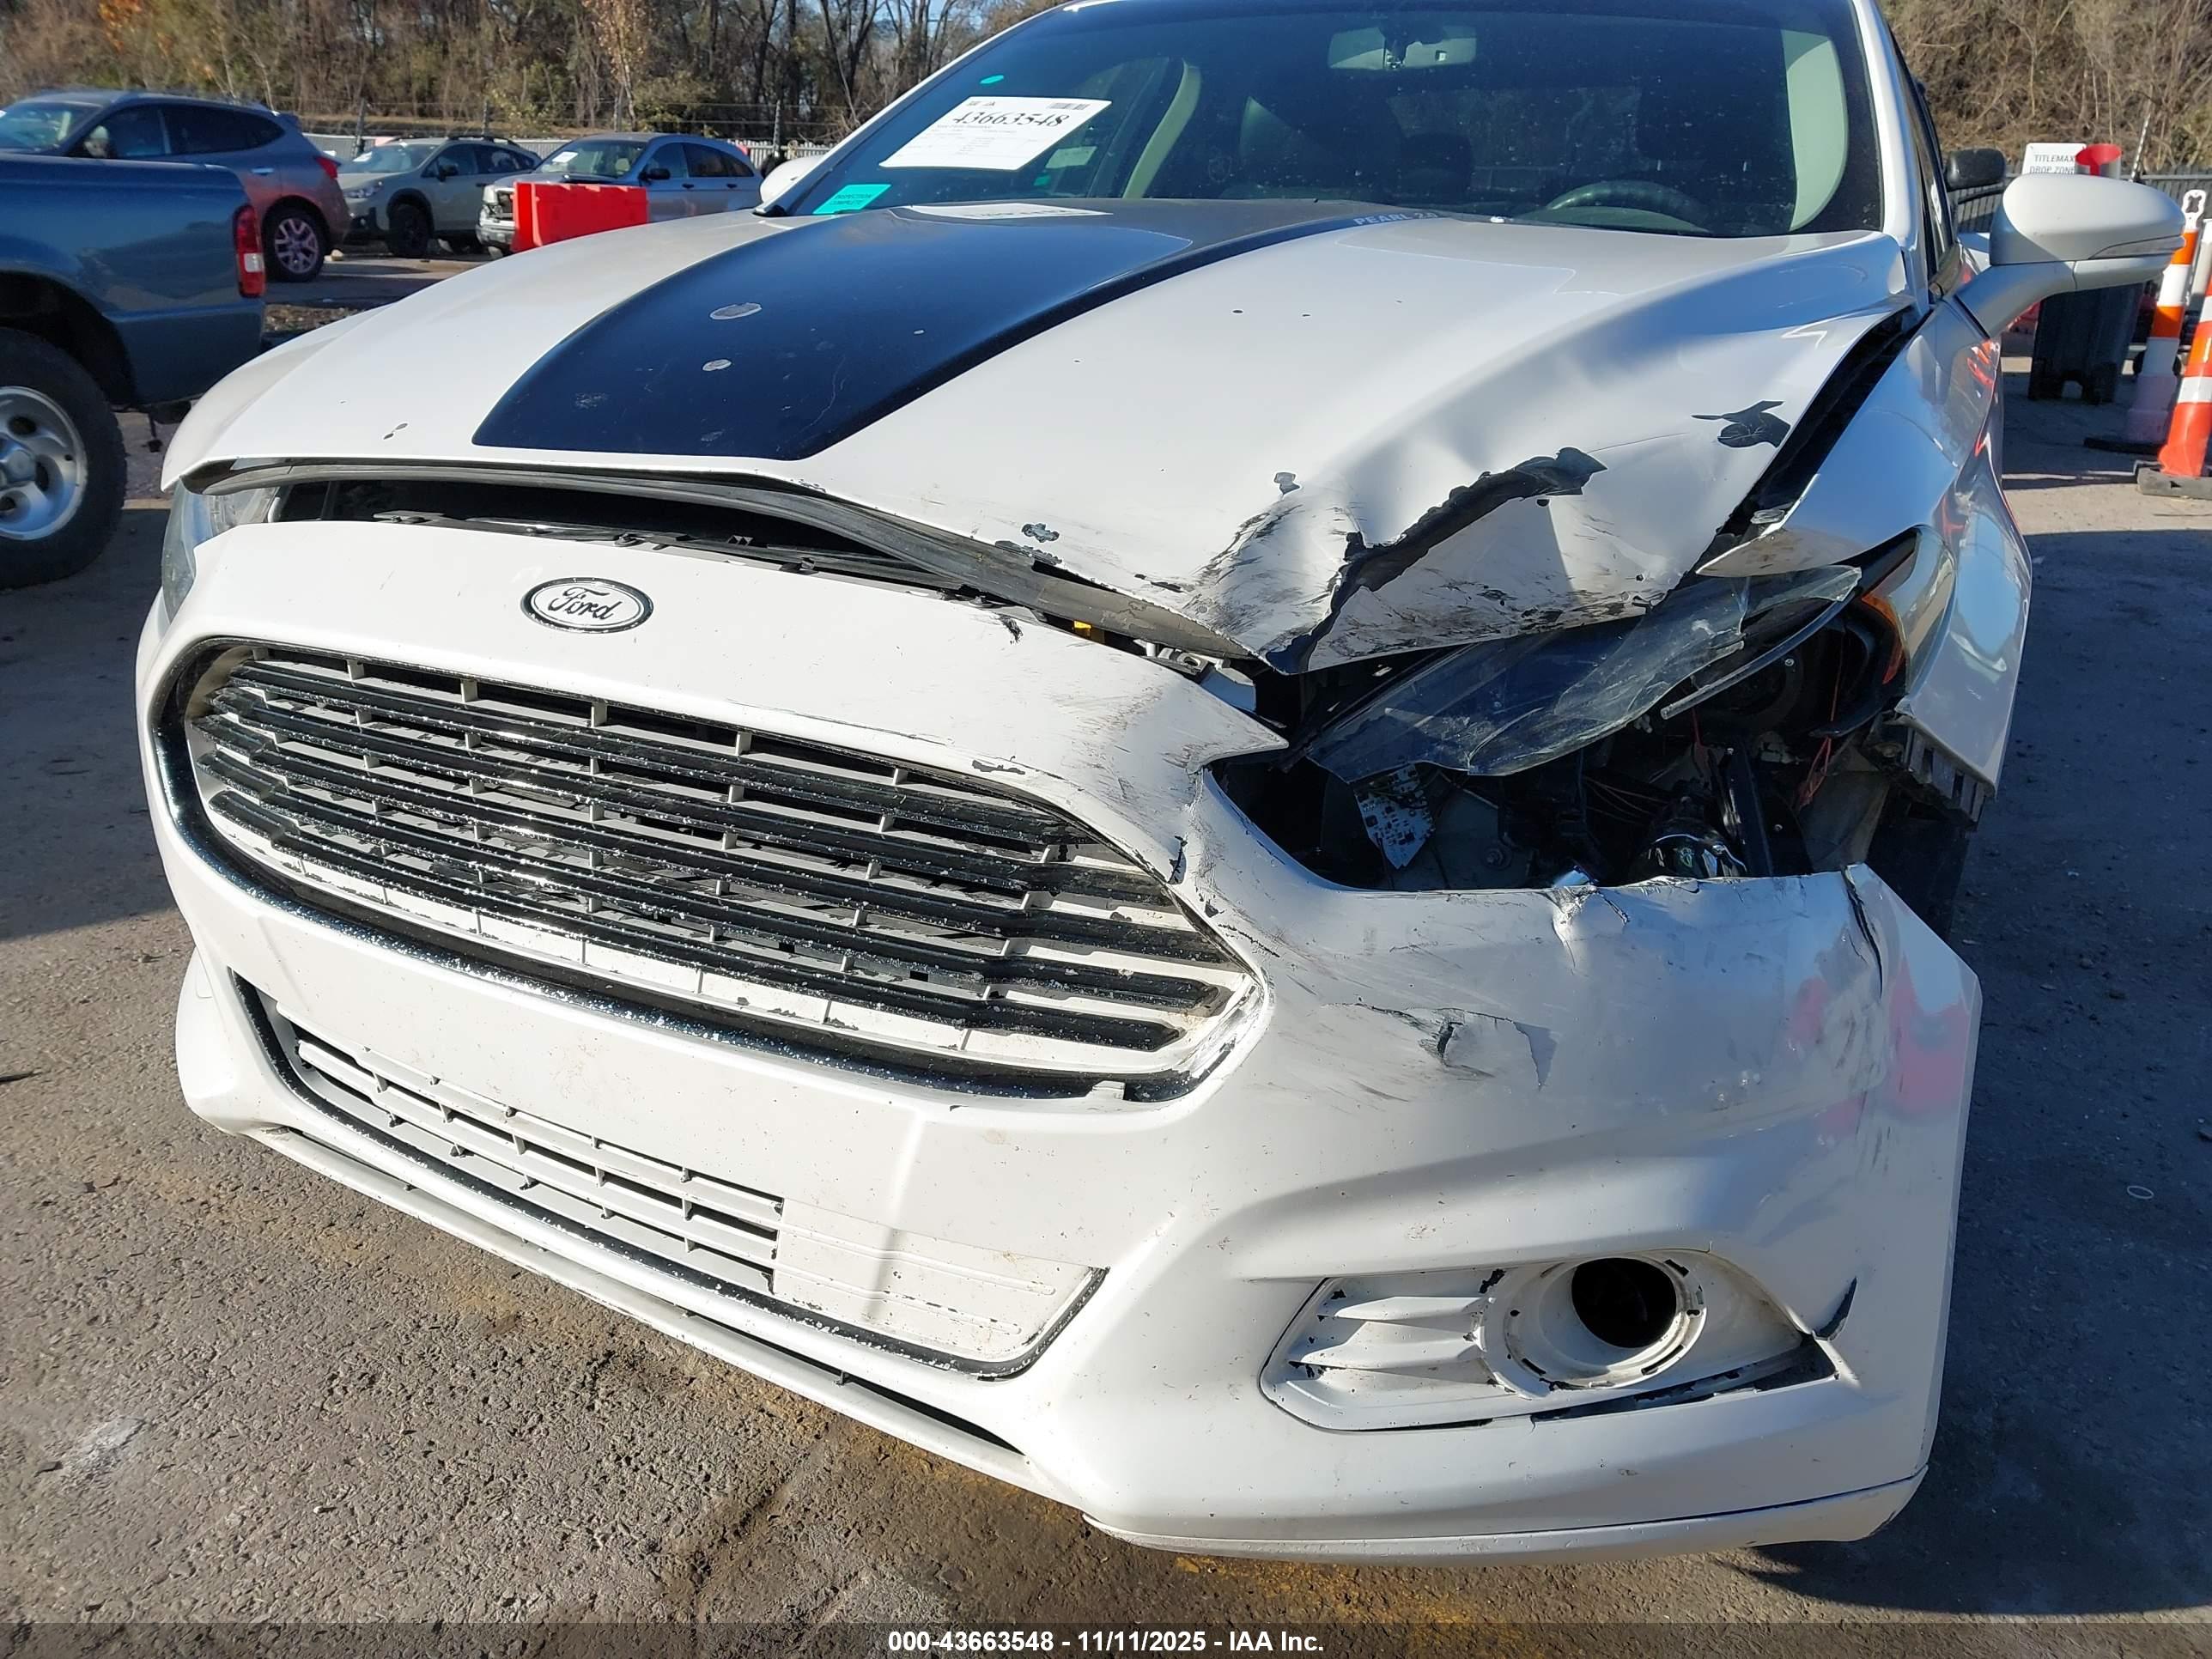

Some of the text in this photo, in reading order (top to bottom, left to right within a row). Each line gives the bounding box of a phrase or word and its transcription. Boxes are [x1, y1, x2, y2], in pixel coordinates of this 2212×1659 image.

[952, 111, 1070, 127] 43663548
[2029, 166, 2052, 174] DROP
[1353, 213, 1413, 225] PEARL
[547, 586, 623, 620] Ford
